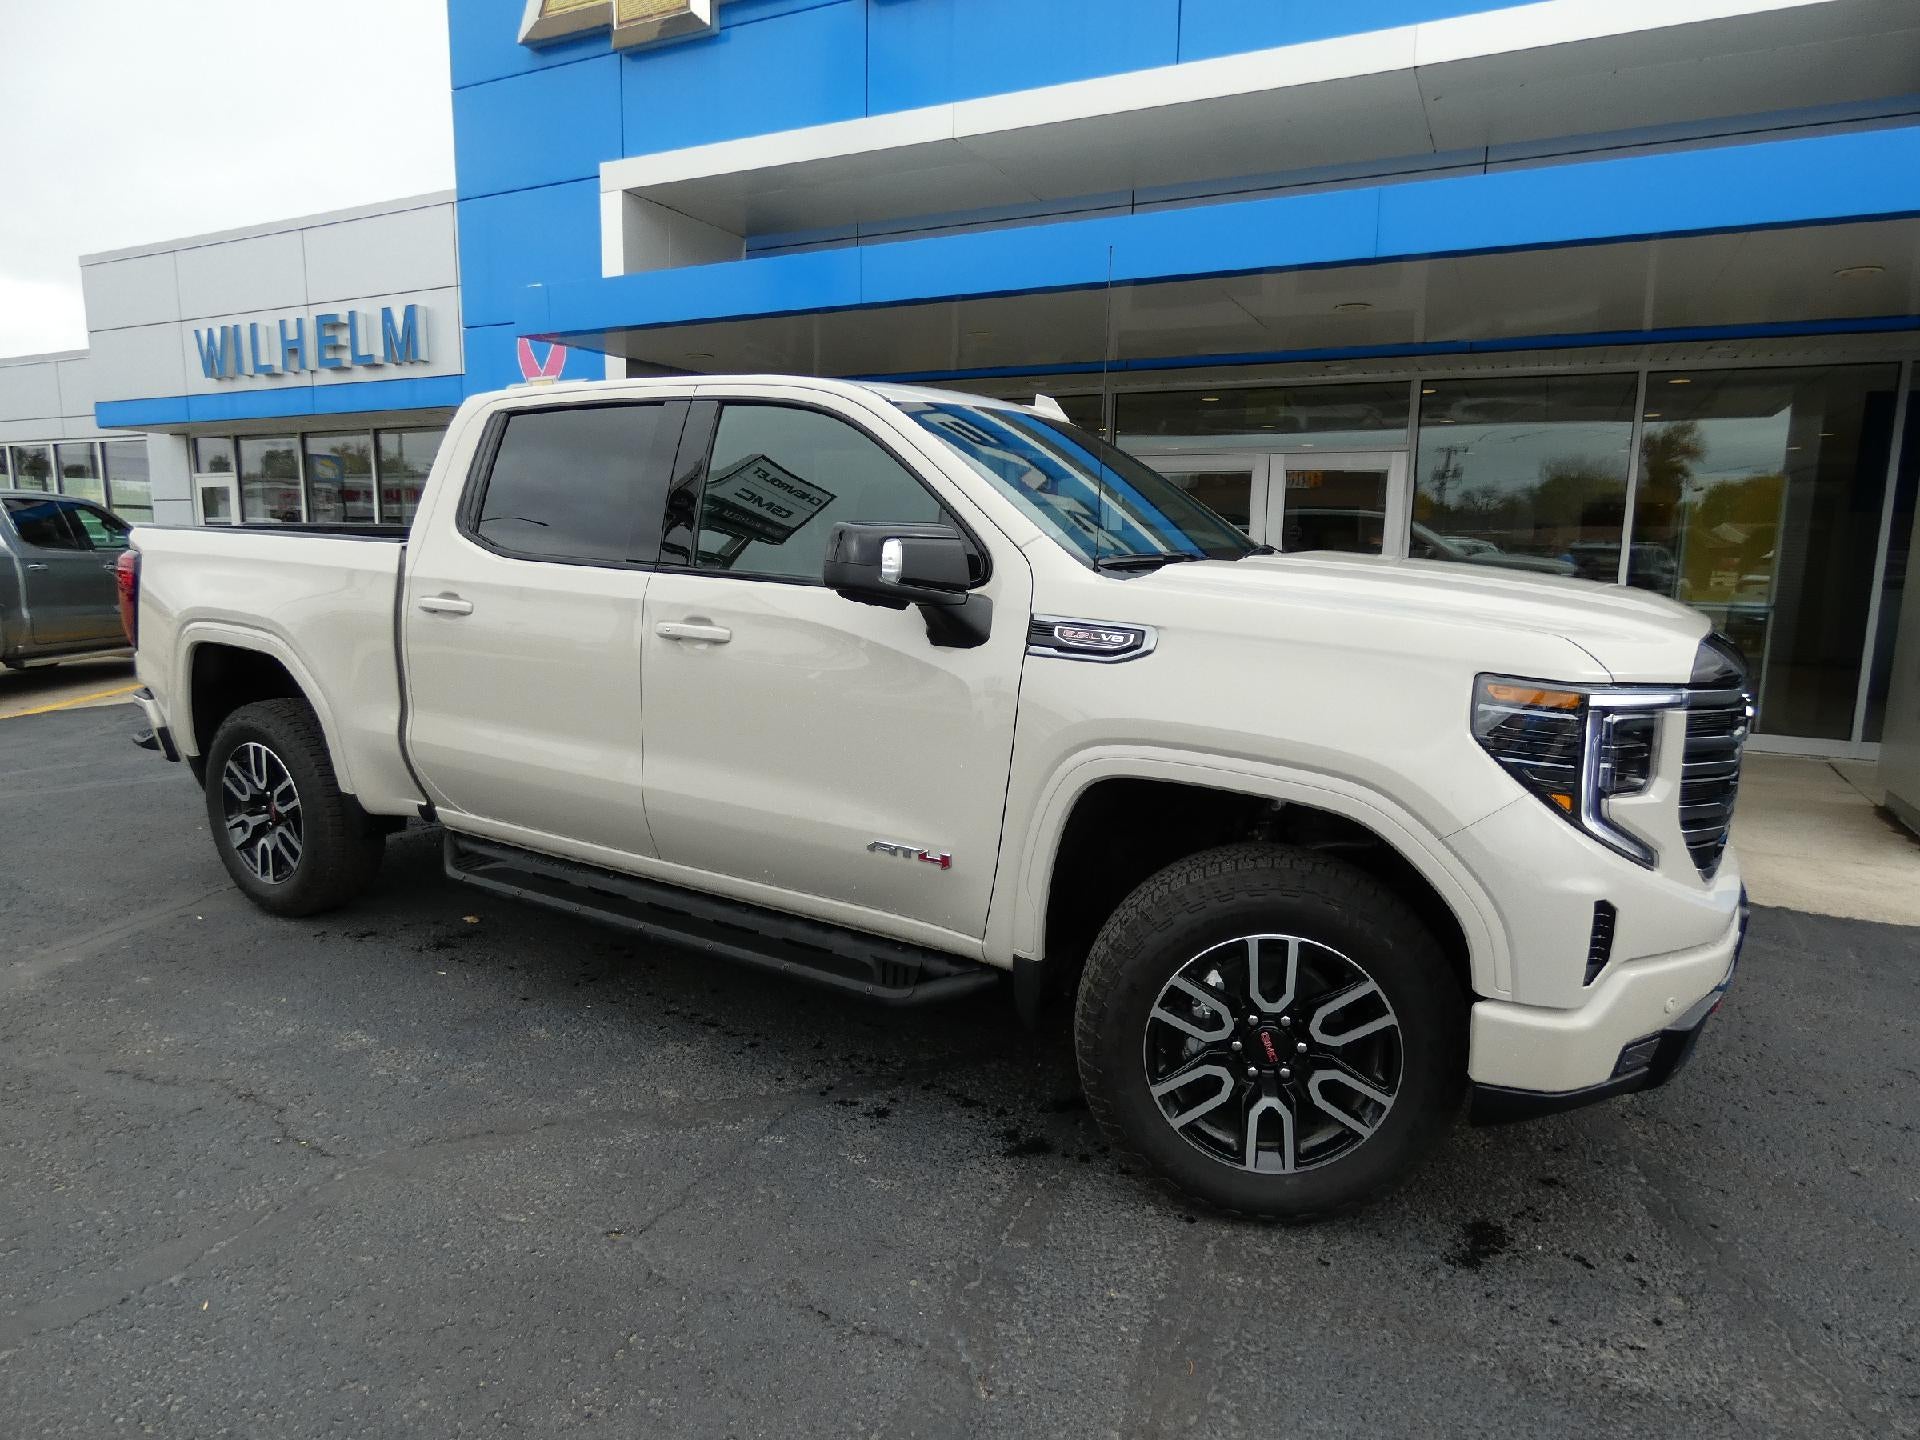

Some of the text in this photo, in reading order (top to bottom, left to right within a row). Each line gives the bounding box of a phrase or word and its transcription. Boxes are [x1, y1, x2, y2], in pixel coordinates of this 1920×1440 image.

[194, 304, 423, 380] WILHELM
[1101, 633, 1125, 643] V8
[866, 840, 952, 871] AT4
